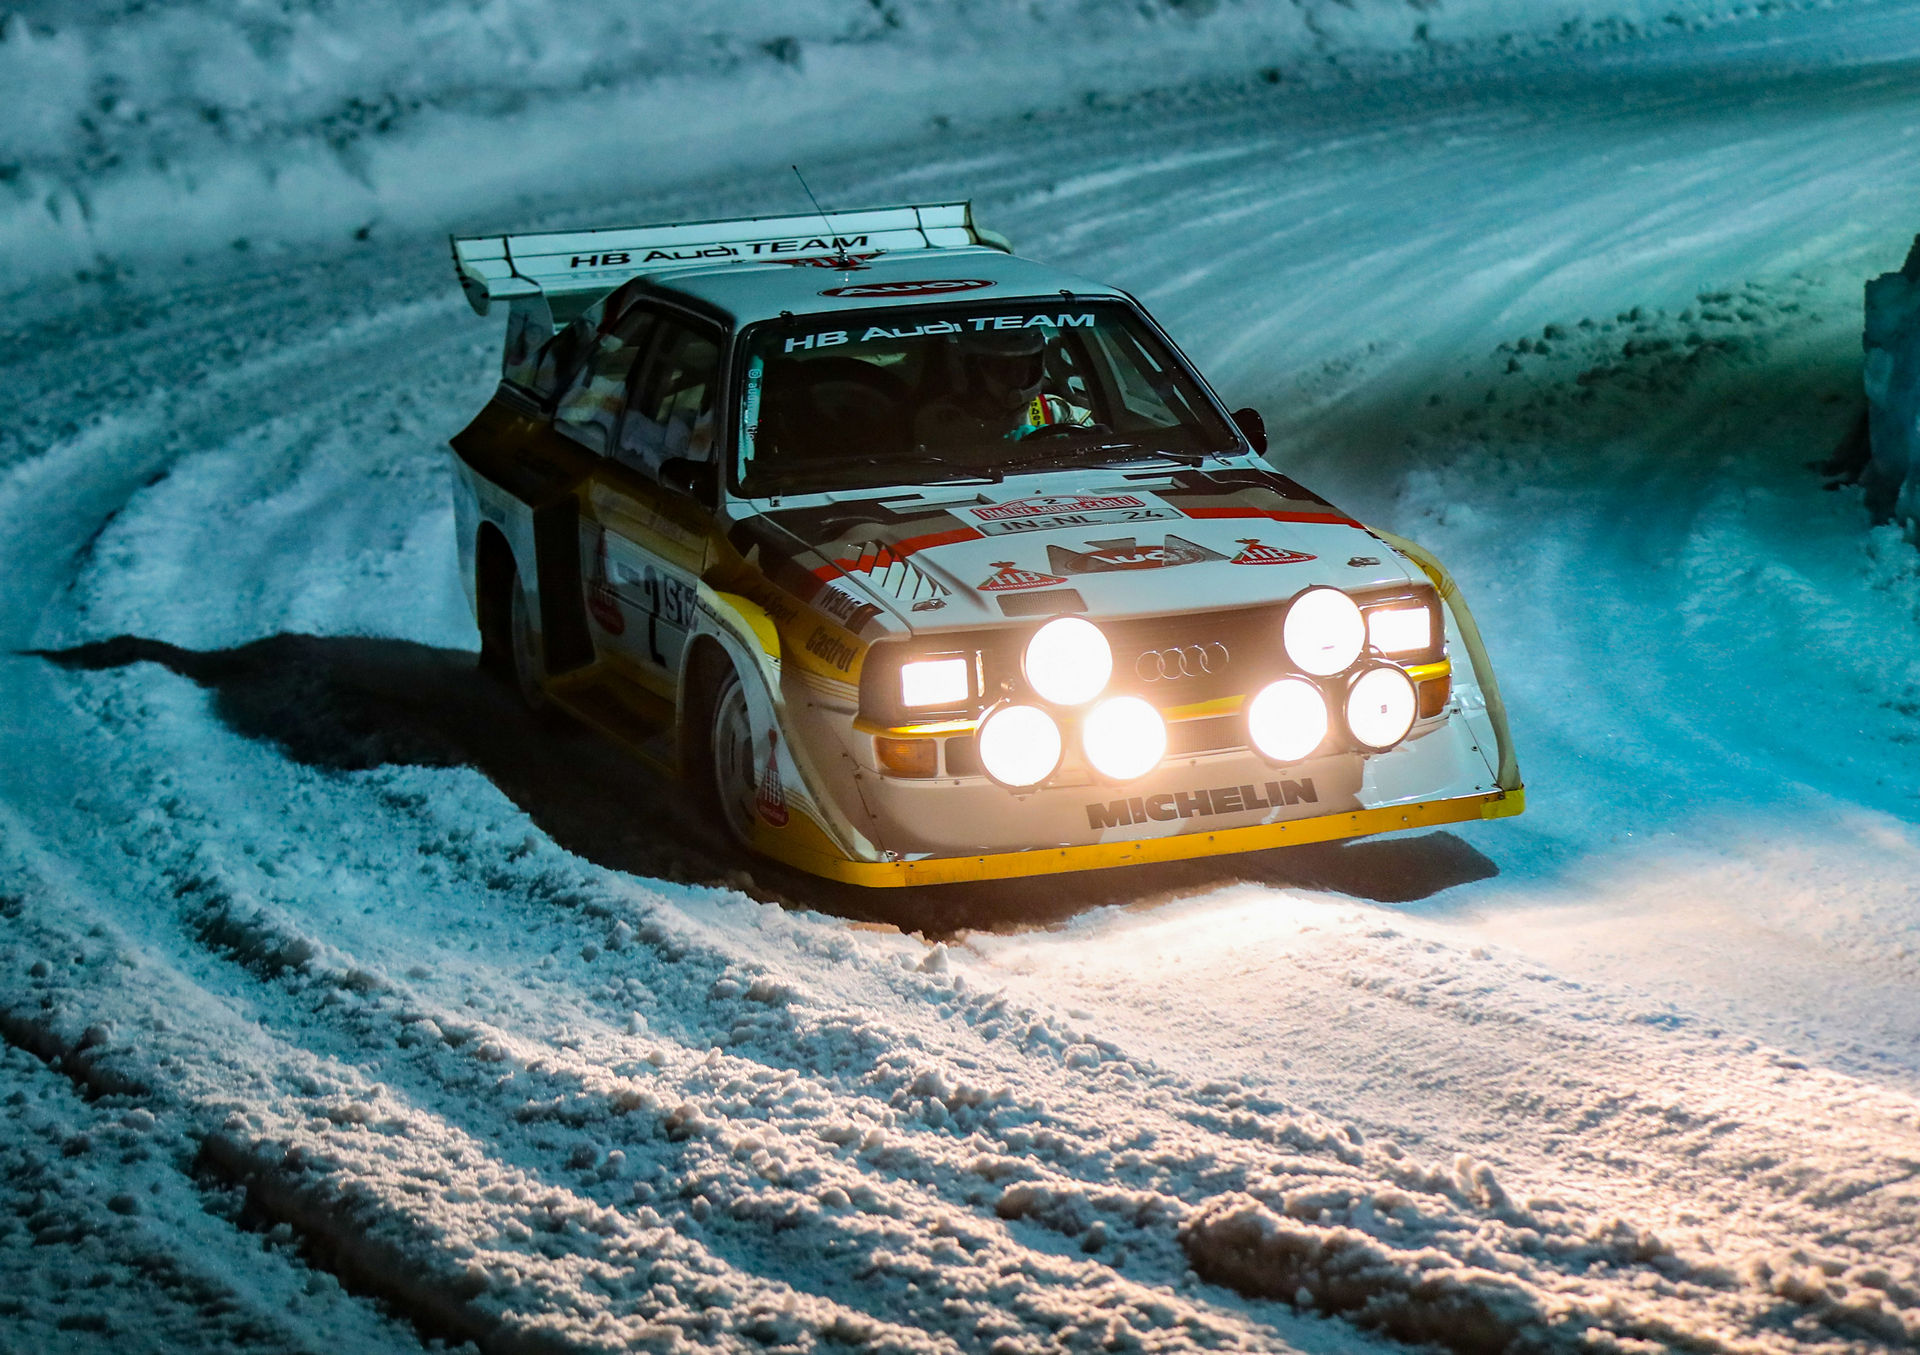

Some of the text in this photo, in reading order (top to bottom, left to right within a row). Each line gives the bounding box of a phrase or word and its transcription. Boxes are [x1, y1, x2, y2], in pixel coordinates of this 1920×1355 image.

[570, 235, 868, 268] HB Audi TEAM
[784, 313, 1095, 353] HB Audi TEAM
[981, 506, 1032, 519] RALLYE
[1120, 509, 1164, 520] 24
[1240, 548, 1292, 560] HB
[992, 571, 1041, 585] HB
[805, 625, 860, 673] Castrol
[1085, 777, 1319, 829] MICHELIN
